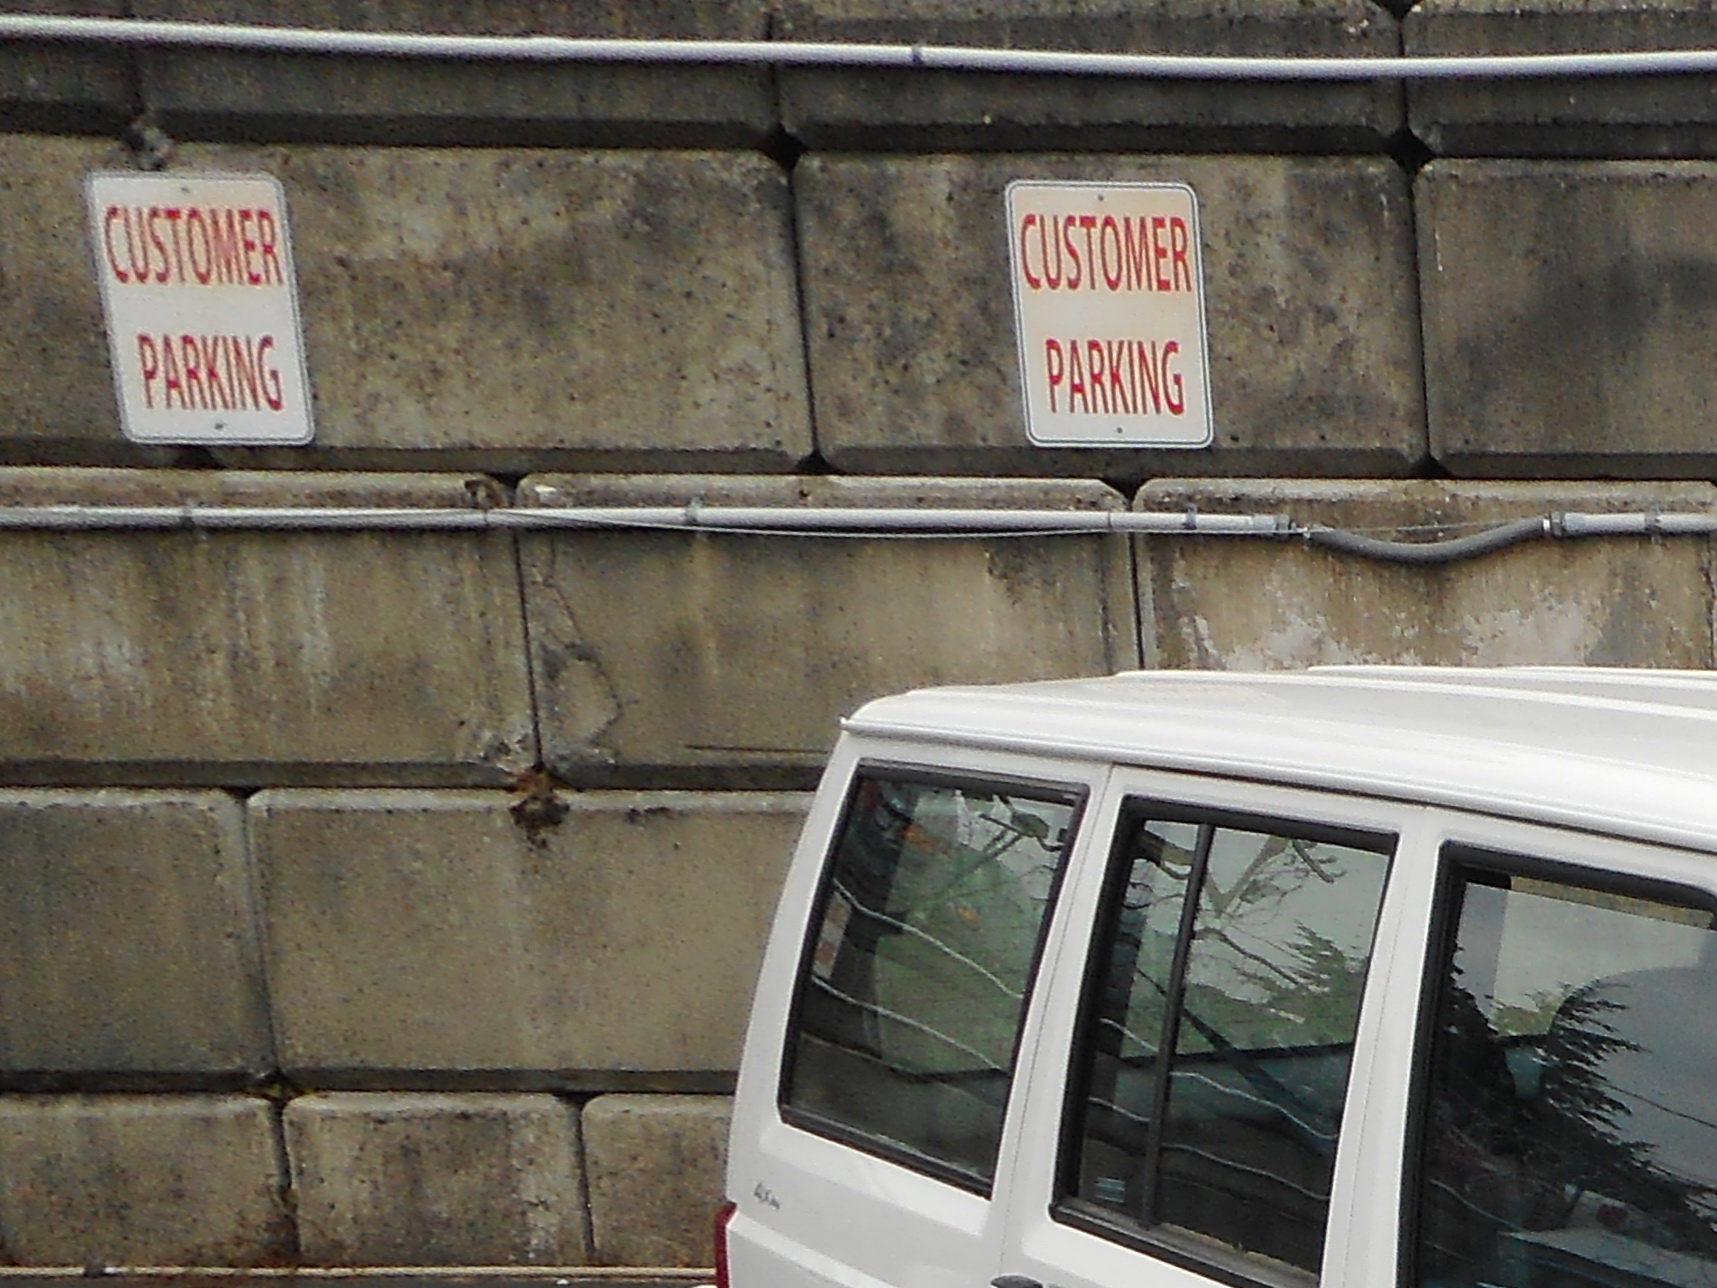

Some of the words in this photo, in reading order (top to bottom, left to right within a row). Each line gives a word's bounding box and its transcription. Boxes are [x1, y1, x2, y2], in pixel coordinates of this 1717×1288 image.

[106, 207, 280, 286] CUSTOMER
[1021, 213, 1192, 292] CUSTOMER
[139, 335, 284, 411] PARKING
[1046, 338, 1185, 416] PARKING
